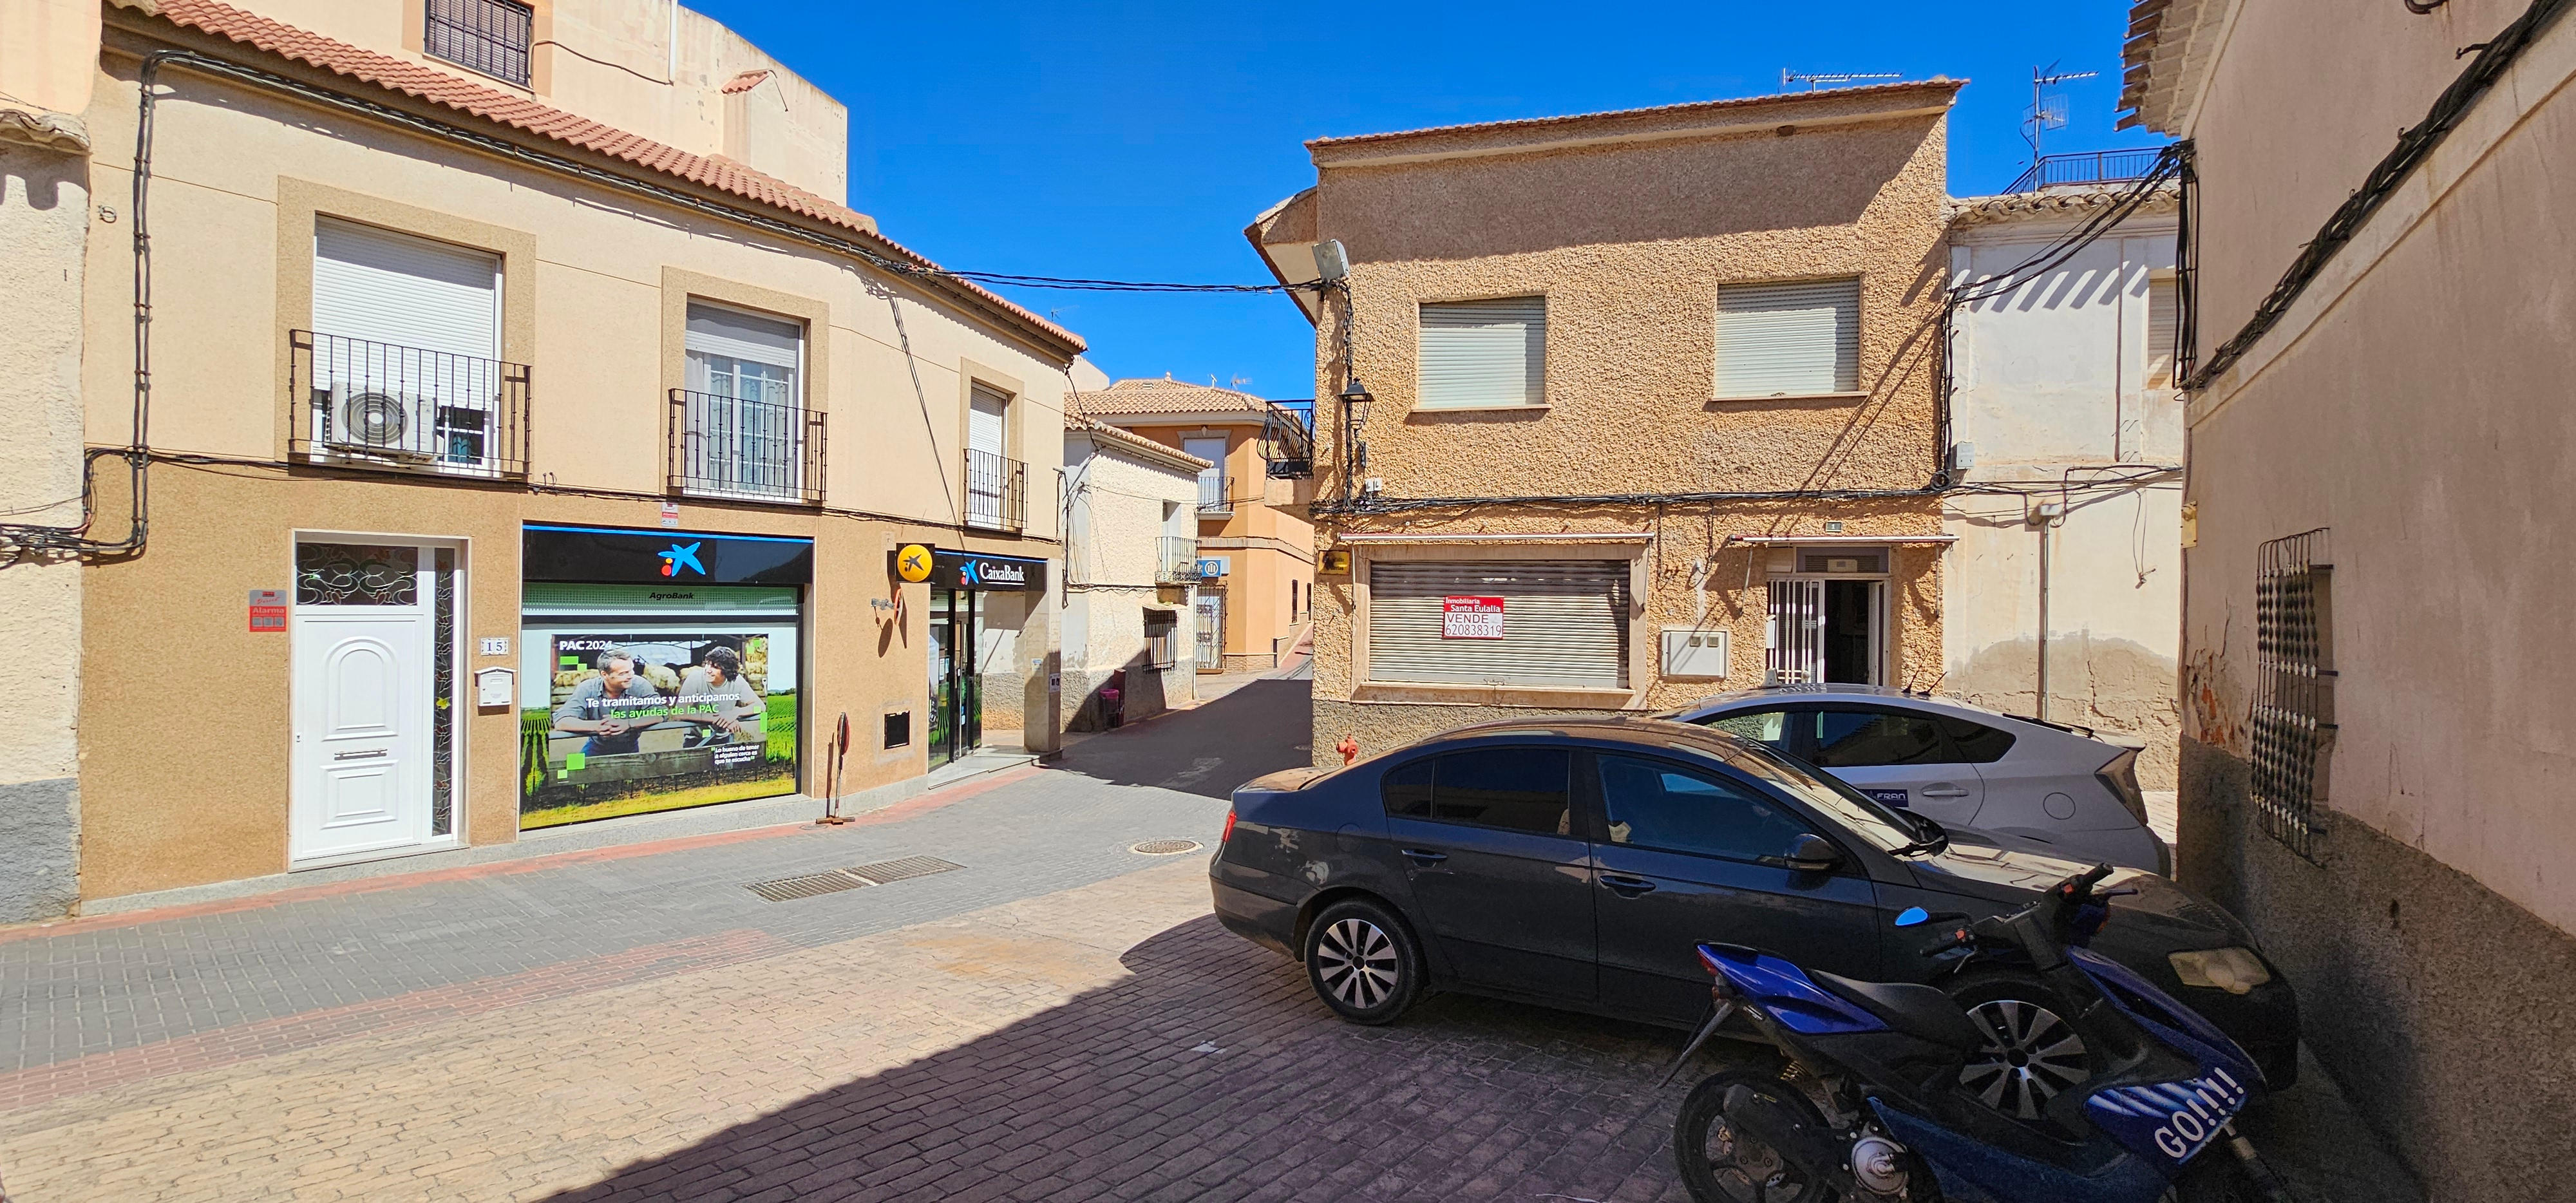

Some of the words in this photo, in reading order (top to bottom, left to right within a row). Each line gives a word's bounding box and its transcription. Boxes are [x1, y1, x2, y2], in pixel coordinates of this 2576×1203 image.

[980, 562, 1025, 582] CaixaBank
[1447, 614, 1488, 623] VENDE
[1446, 624, 1501, 636] 620838319
[560, 640, 585, 650] PAC
[585, 698, 599, 708] Te
[601, 696, 667, 707] tramitamos
[668, 696, 676, 706] y
[678, 692, 740, 704] anticipamos
[611, 709, 626, 719] las
[629, 707, 668, 719] ayudas
[671, 706, 684, 715] de
[687, 705, 696, 714] la
[699, 705, 719, 714] PAC
[2155, 1067, 2244, 1158] GO!!!!
